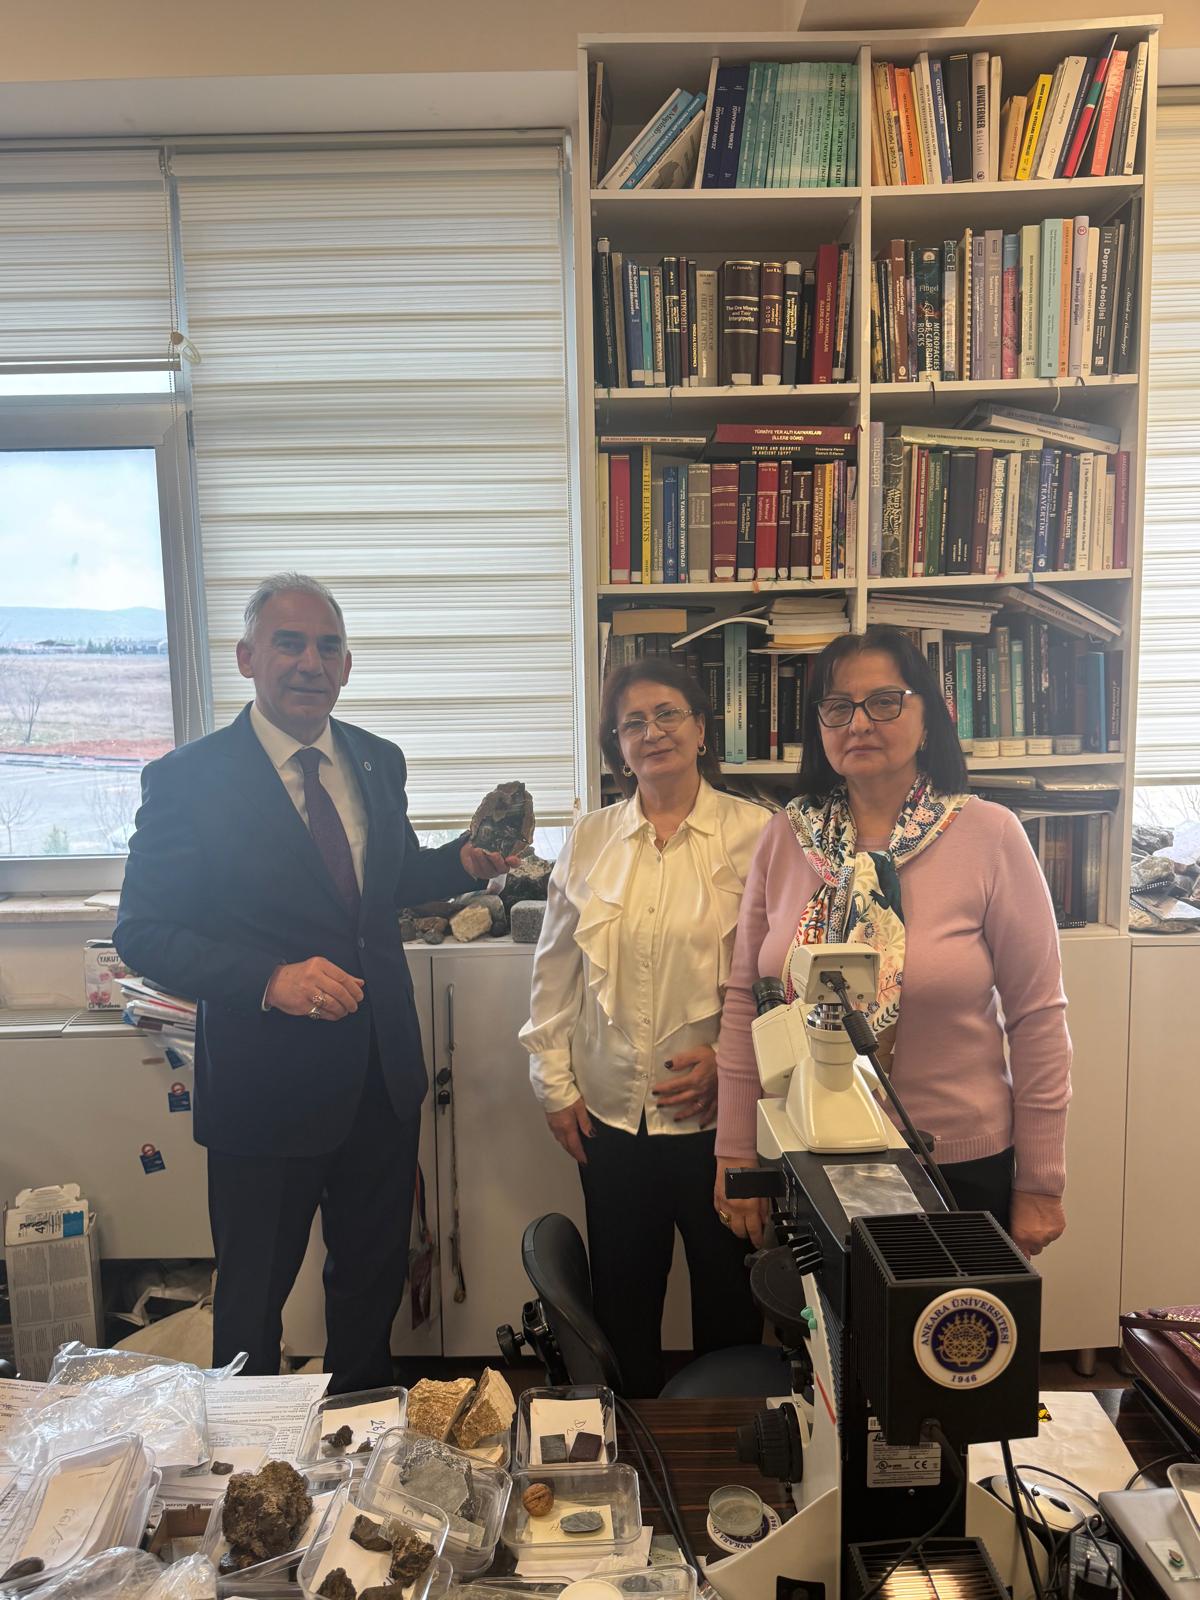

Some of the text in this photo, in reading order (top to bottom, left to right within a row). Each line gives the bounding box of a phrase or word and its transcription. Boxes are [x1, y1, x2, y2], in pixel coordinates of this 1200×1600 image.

[976, 84, 986, 129] KUVATERNER
[1099, 248, 1111, 320] Deprem Jeolojisi
[917, 323, 925, 347] ROCKS
[925, 335, 933, 371] CARBONAT
[871, 437, 881, 488] Edelsteine
[992, 459, 1006, 535] Applied Geostatistics
[1039, 483, 1047, 537] TRAVERTINE
[921, 1296, 1009, 1346] ANKARA ÜNİVERSİTESİ
[952, 1374, 977, 1383] 1946
[914, 1460, 928, 1469] CE
[719, 1534, 753, 1550] ANKARA
